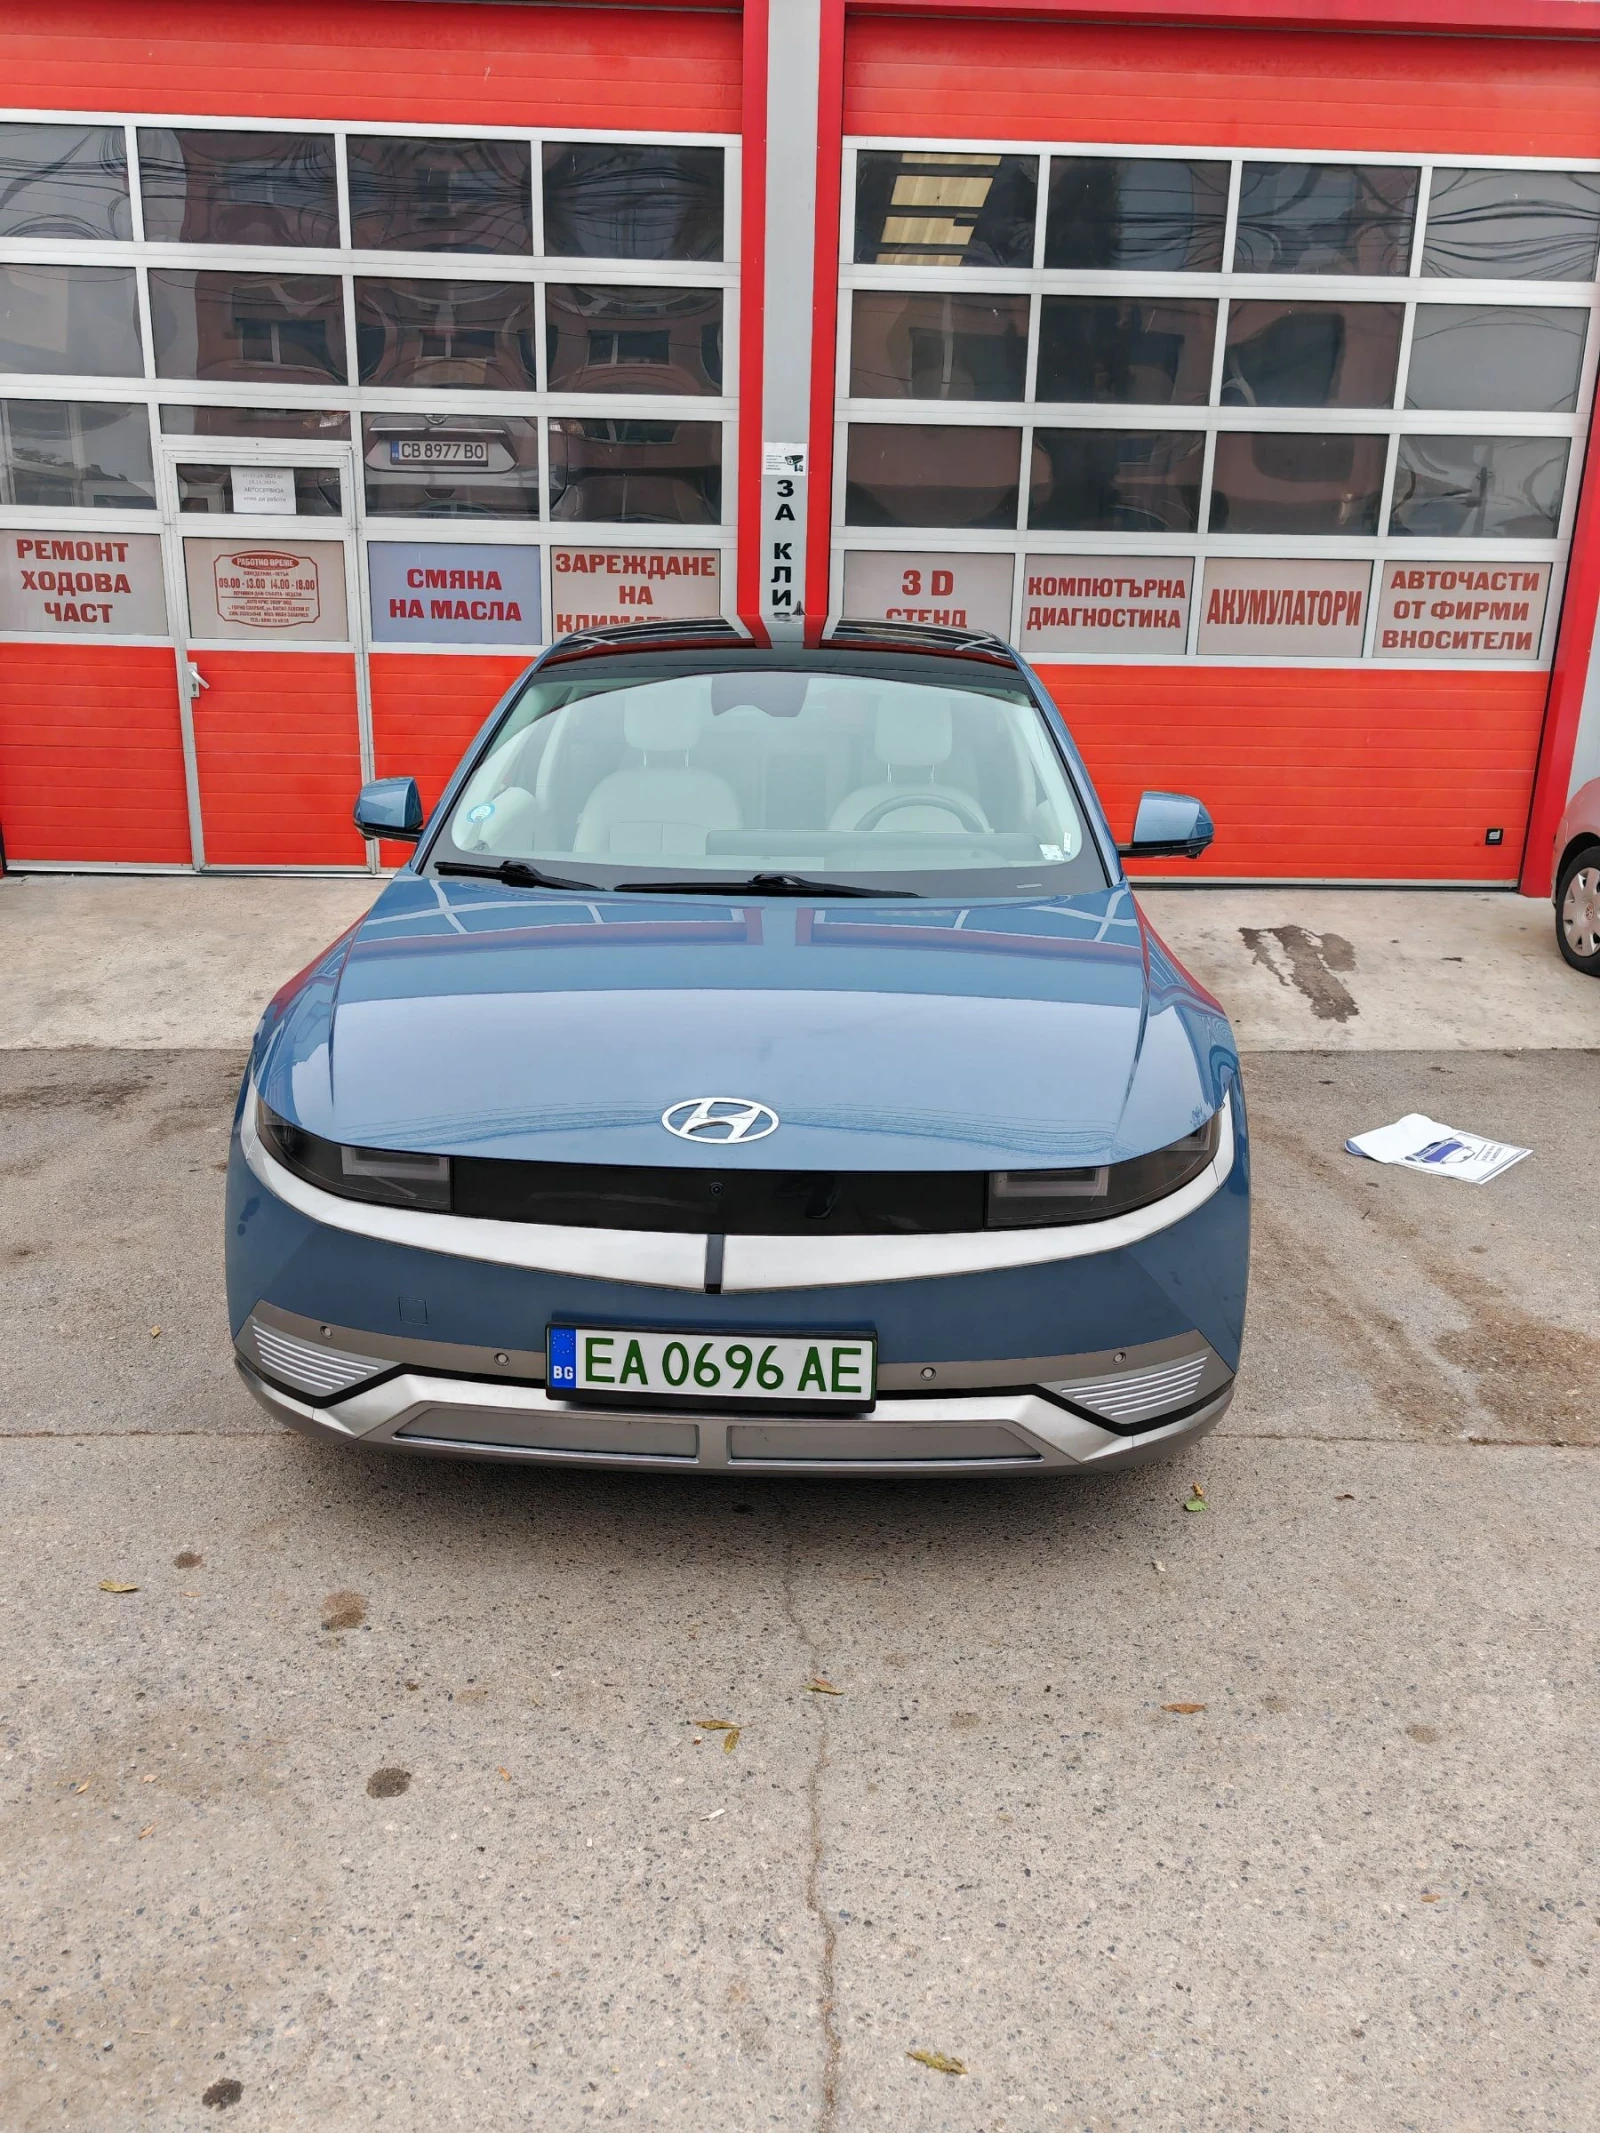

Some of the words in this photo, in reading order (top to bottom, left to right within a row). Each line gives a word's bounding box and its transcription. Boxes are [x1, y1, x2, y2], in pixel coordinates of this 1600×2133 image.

[401, 443, 421, 458] CB
[424, 443, 459, 459] 8977
[463, 444, 484, 459] BO
[774, 479, 796, 521] ЗА
[16, 539, 129, 562] РЕМОНТ
[555, 553, 715, 580] ЗАРЕЖДАНЕ
[20, 570, 132, 596] ХОДОВА
[218, 577, 240, 589] 09.00
[246, 578, 265, 589] 13.00
[270, 578, 290, 590] 14.00
[295, 579, 315, 590] 18.00
[407, 568, 502, 590] СМЯНА
[771, 542, 792, 616] КЛИ
[902, 569, 921, 596] 3
[931, 570, 954, 596] D
[1028, 577, 1185, 599] КОМПЮТЪРНА
[1390, 570, 1540, 591] АВТОЧАСТИ
[619, 585, 653, 605] НА
[44, 602, 113, 623] ЧАСТ
[389, 598, 424, 618] НА
[430, 600, 522, 621] МАСЛА
[1026, 607, 1181, 630] ДИАГНОСТИКА
[1206, 589, 1363, 626] АКУМУЛАТОРИ
[1393, 600, 1426, 619] ОТ
[1430, 600, 1530, 621] ФИРМИ
[1382, 629, 1533, 650] ВНОСИТЕЛИ
[553, 1365, 574, 1379] BG
[585, 1337, 648, 1385] EA
[662, 1341, 784, 1390] 0696
[797, 1346, 862, 1393] AE
